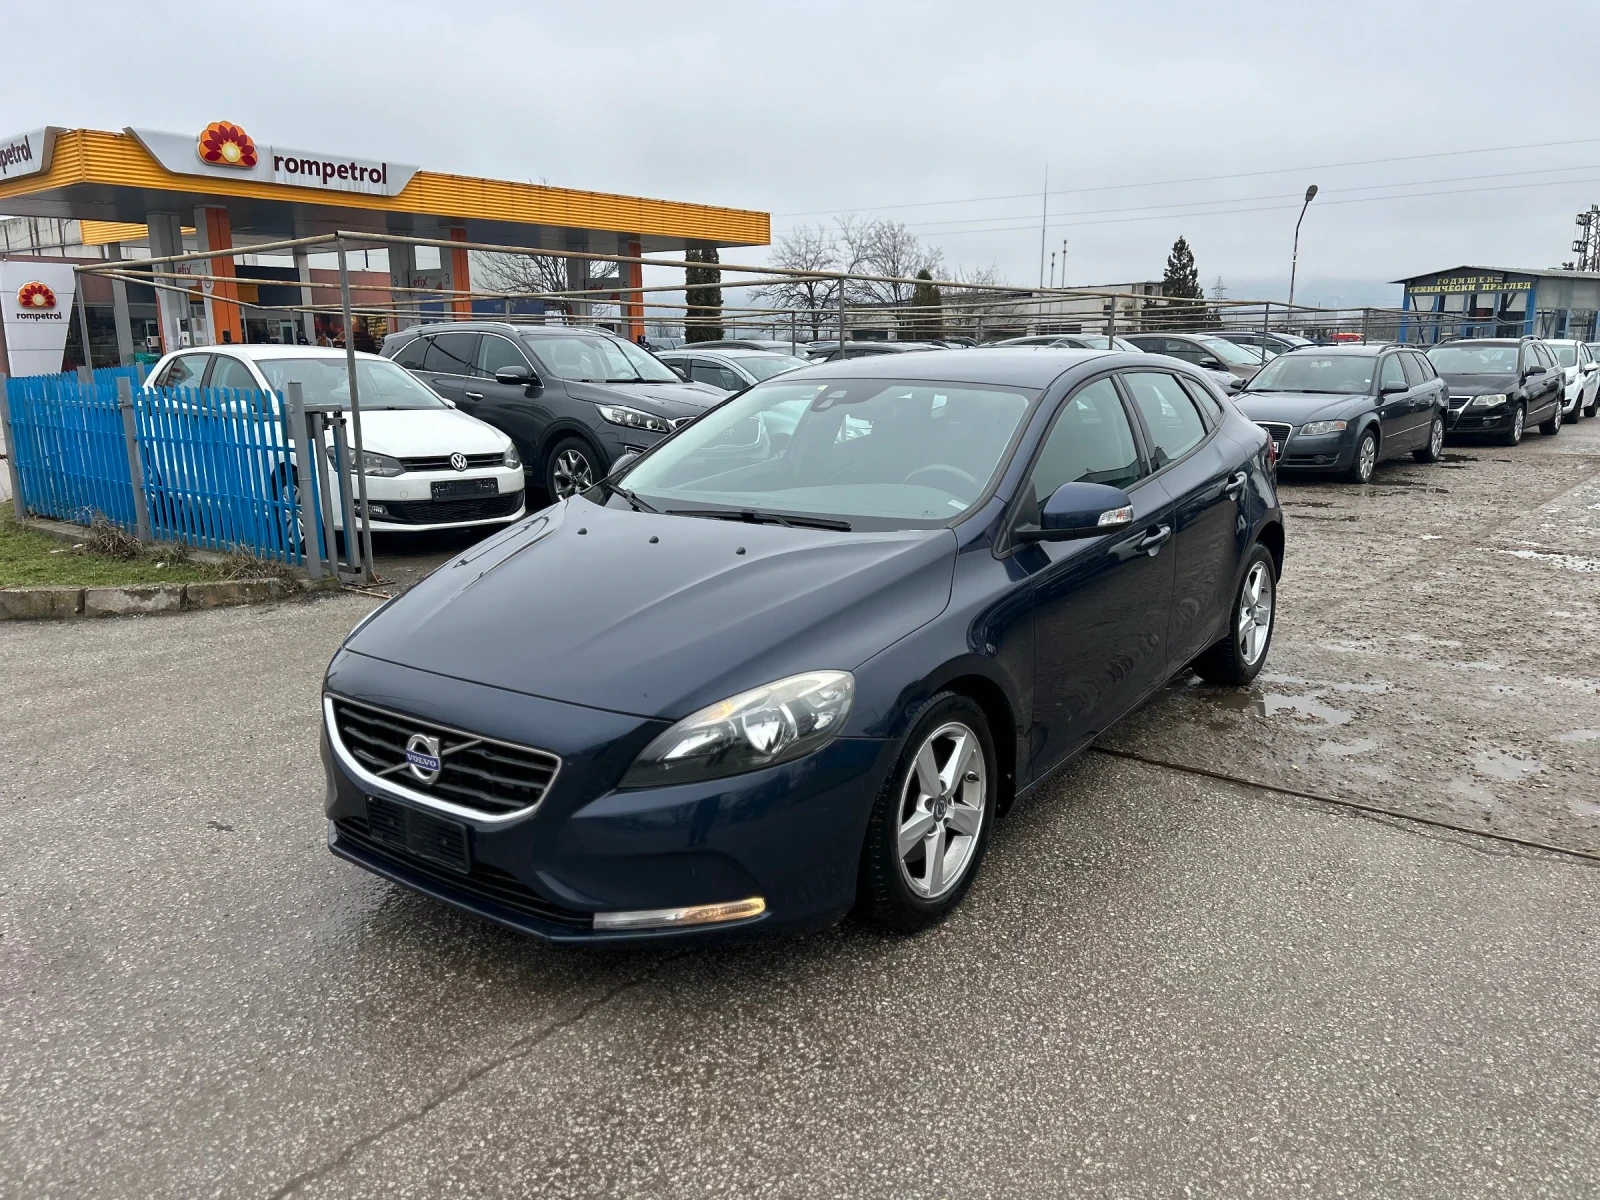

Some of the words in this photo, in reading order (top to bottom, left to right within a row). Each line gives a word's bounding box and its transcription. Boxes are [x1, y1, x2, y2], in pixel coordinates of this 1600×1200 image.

[0, 134, 33, 175] petrol
[273, 155, 387, 185] rompetrol
[413, 275, 428, 287] efix
[1437, 276, 1494, 285] ГОДИШЕН
[1408, 284, 1476, 293] ТЕХНИЧЕСКИ
[1482, 281, 1532, 291] ПРЕГЛЕД
[16, 311, 62, 322] rompetrol
[406, 752, 437, 768] VOLVO
